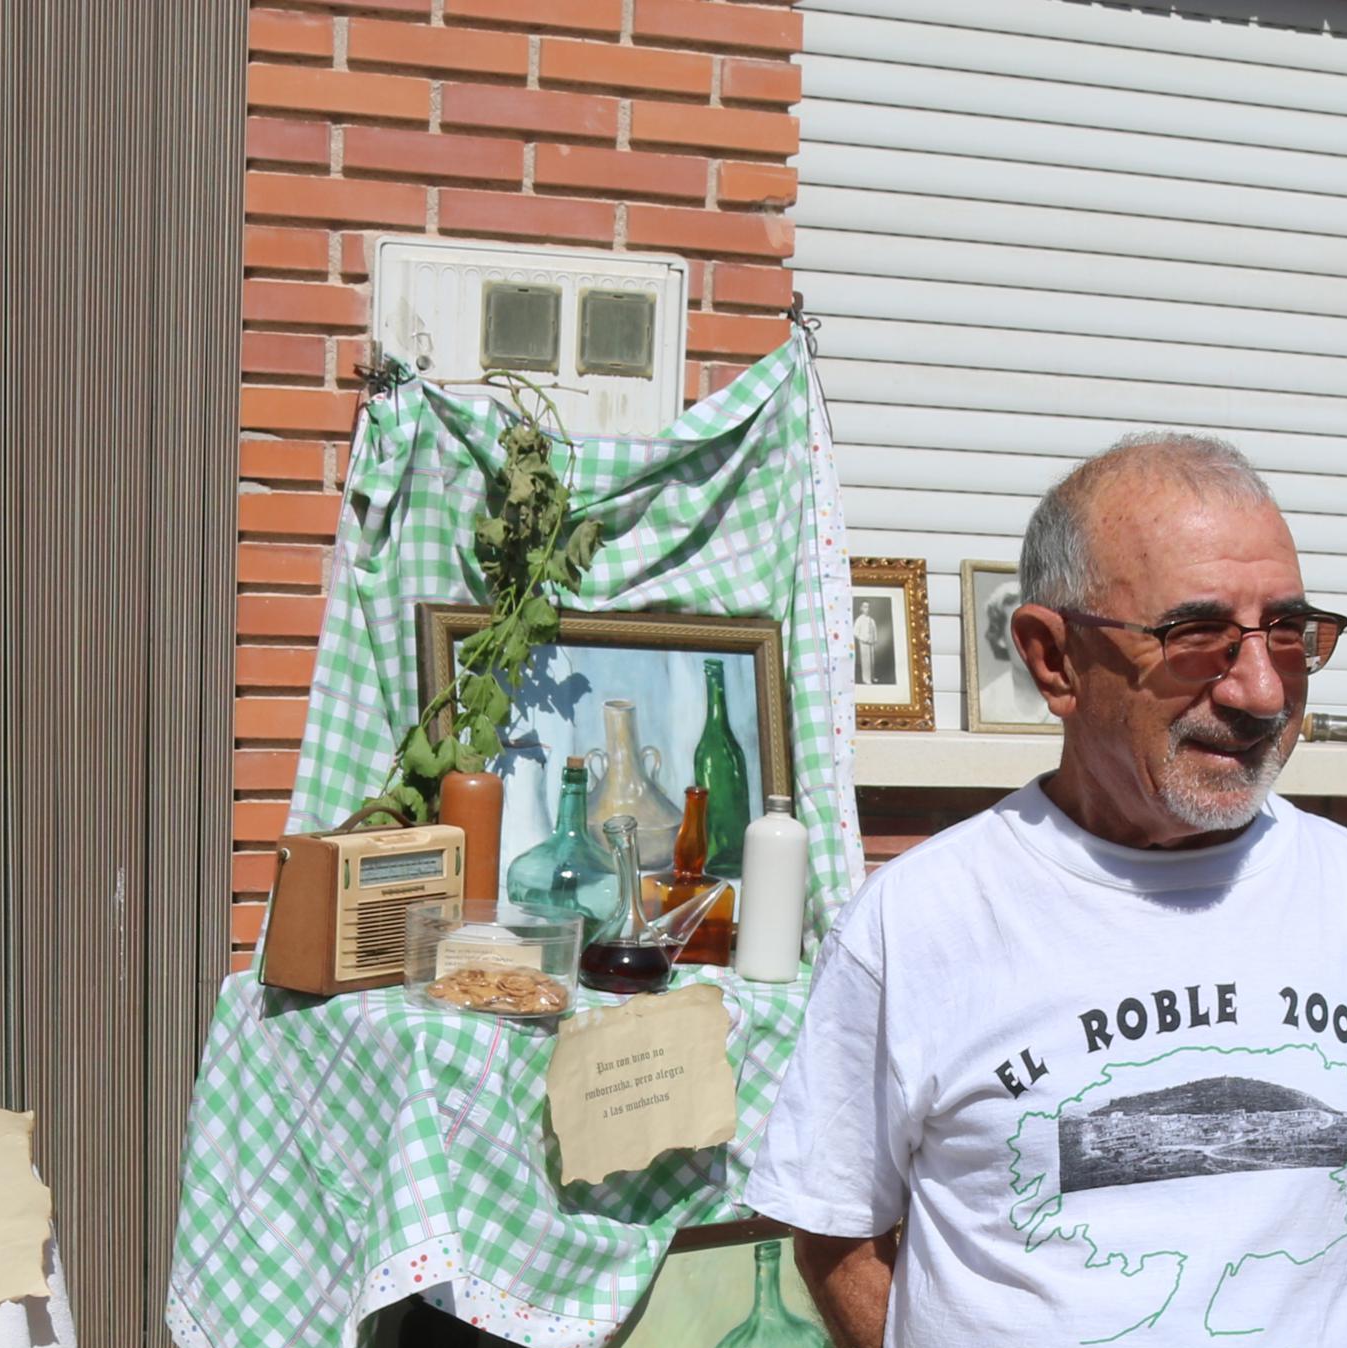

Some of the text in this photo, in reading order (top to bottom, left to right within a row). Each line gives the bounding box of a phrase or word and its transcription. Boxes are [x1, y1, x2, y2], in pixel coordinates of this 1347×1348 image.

[995, 1046, 1049, 1099] EL
[1079, 981, 1239, 1053] ROBLE
[596, 1061, 614, 1075] Pan
[632, 1051, 651, 1063] vino
[652, 1048, 664, 1058] no
[634, 1073, 653, 1087] pero
[655, 1065, 685, 1081] alegra
[610, 1105, 624, 1117] las
[625, 1092, 670, 1112] muchachas
